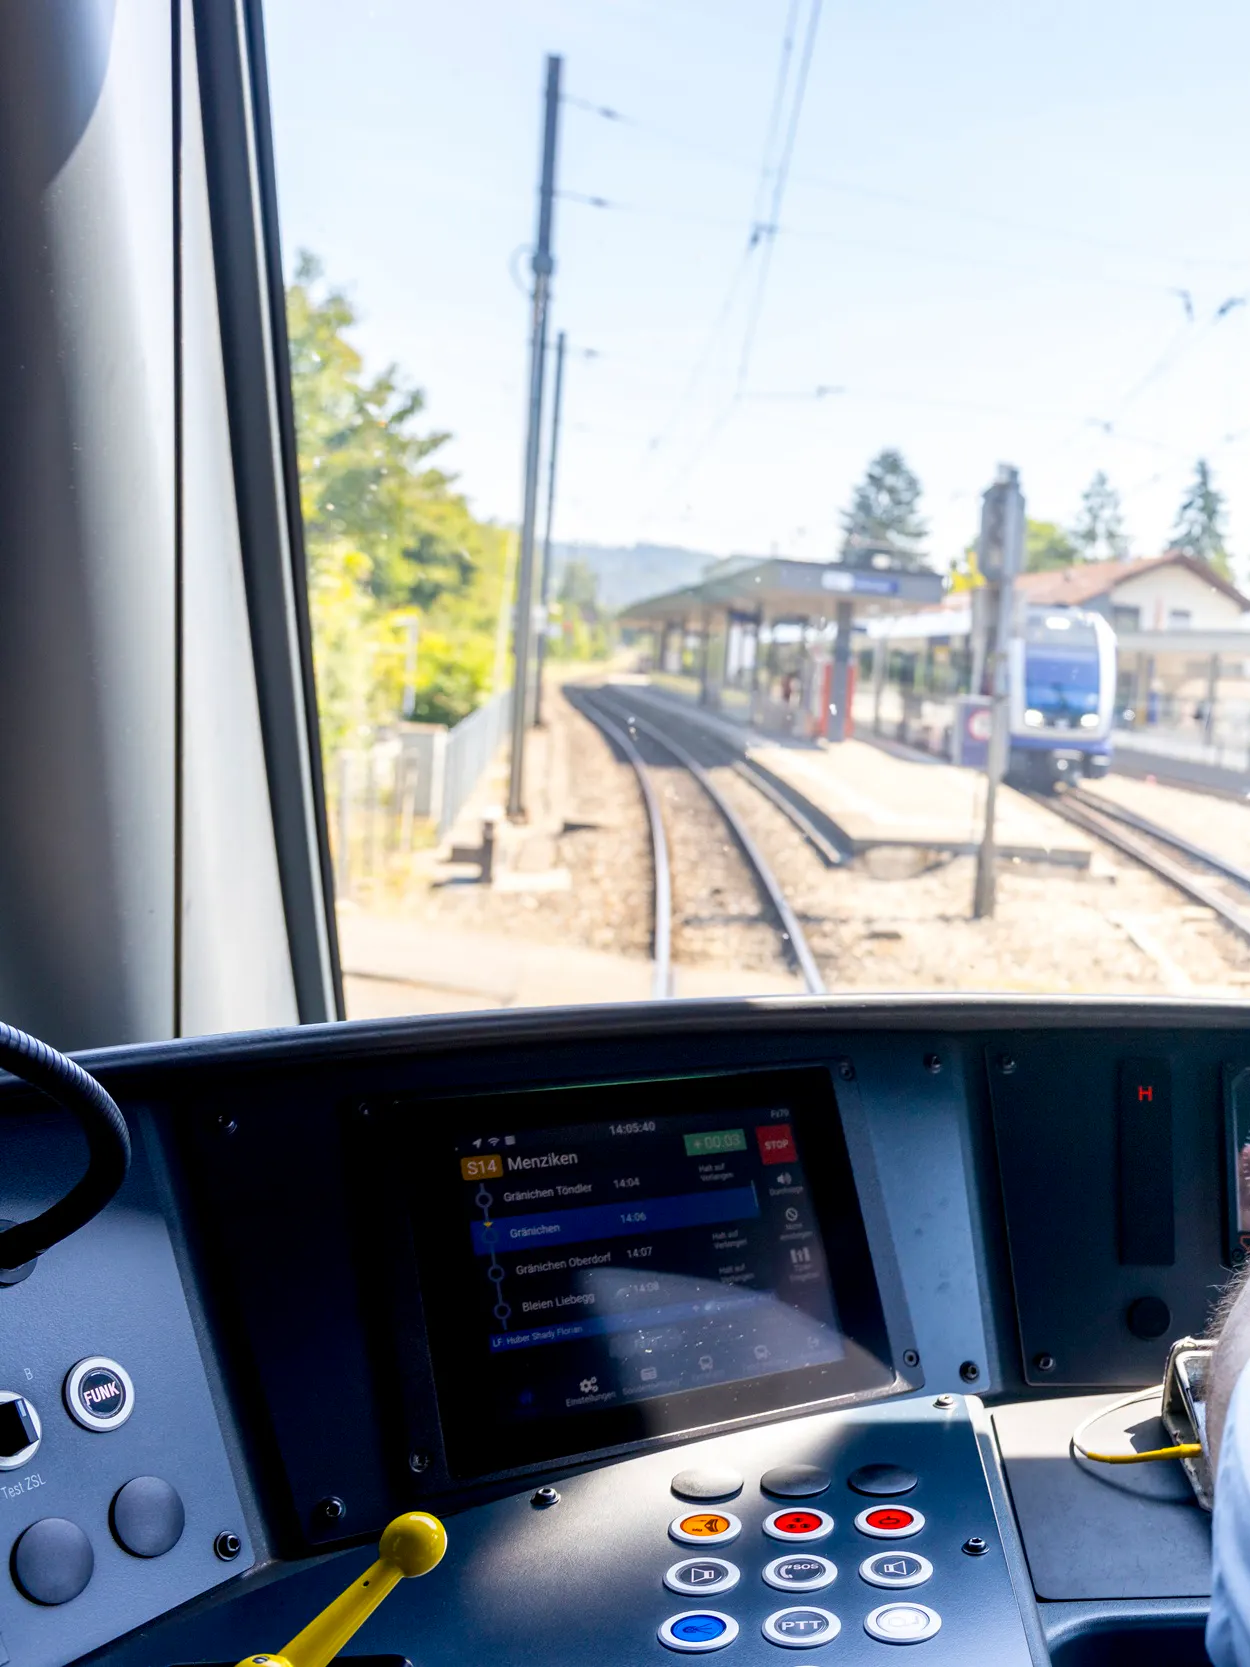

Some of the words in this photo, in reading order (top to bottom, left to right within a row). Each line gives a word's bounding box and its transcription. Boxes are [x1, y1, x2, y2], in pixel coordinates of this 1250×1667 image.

[1138, 1085, 1153, 1101] H
[609, 1121, 656, 1136] 14:05:40
[764, 1139, 789, 1151] STOP
[467, 1159, 498, 1175] S14
[507, 1152, 579, 1171] Menziken
[503, 1187, 554, 1202] Gränichen
[613, 1177, 641, 1189] 14:04
[510, 1223, 561, 1238] Gränichen
[515, 1260, 567, 1276] Gränichen
[568, 1252, 612, 1268] Oberdorf
[522, 1298, 554, 1312] Bleien
[555, 1292, 596, 1307] Liebegg
[23, 1367, 34, 1381] B
[83, 1381, 120, 1406] FUNK
[1, 1484, 25, 1500] Test
[24, 1473, 47, 1491] ZSL
[781, 1620, 822, 1631] PTT
